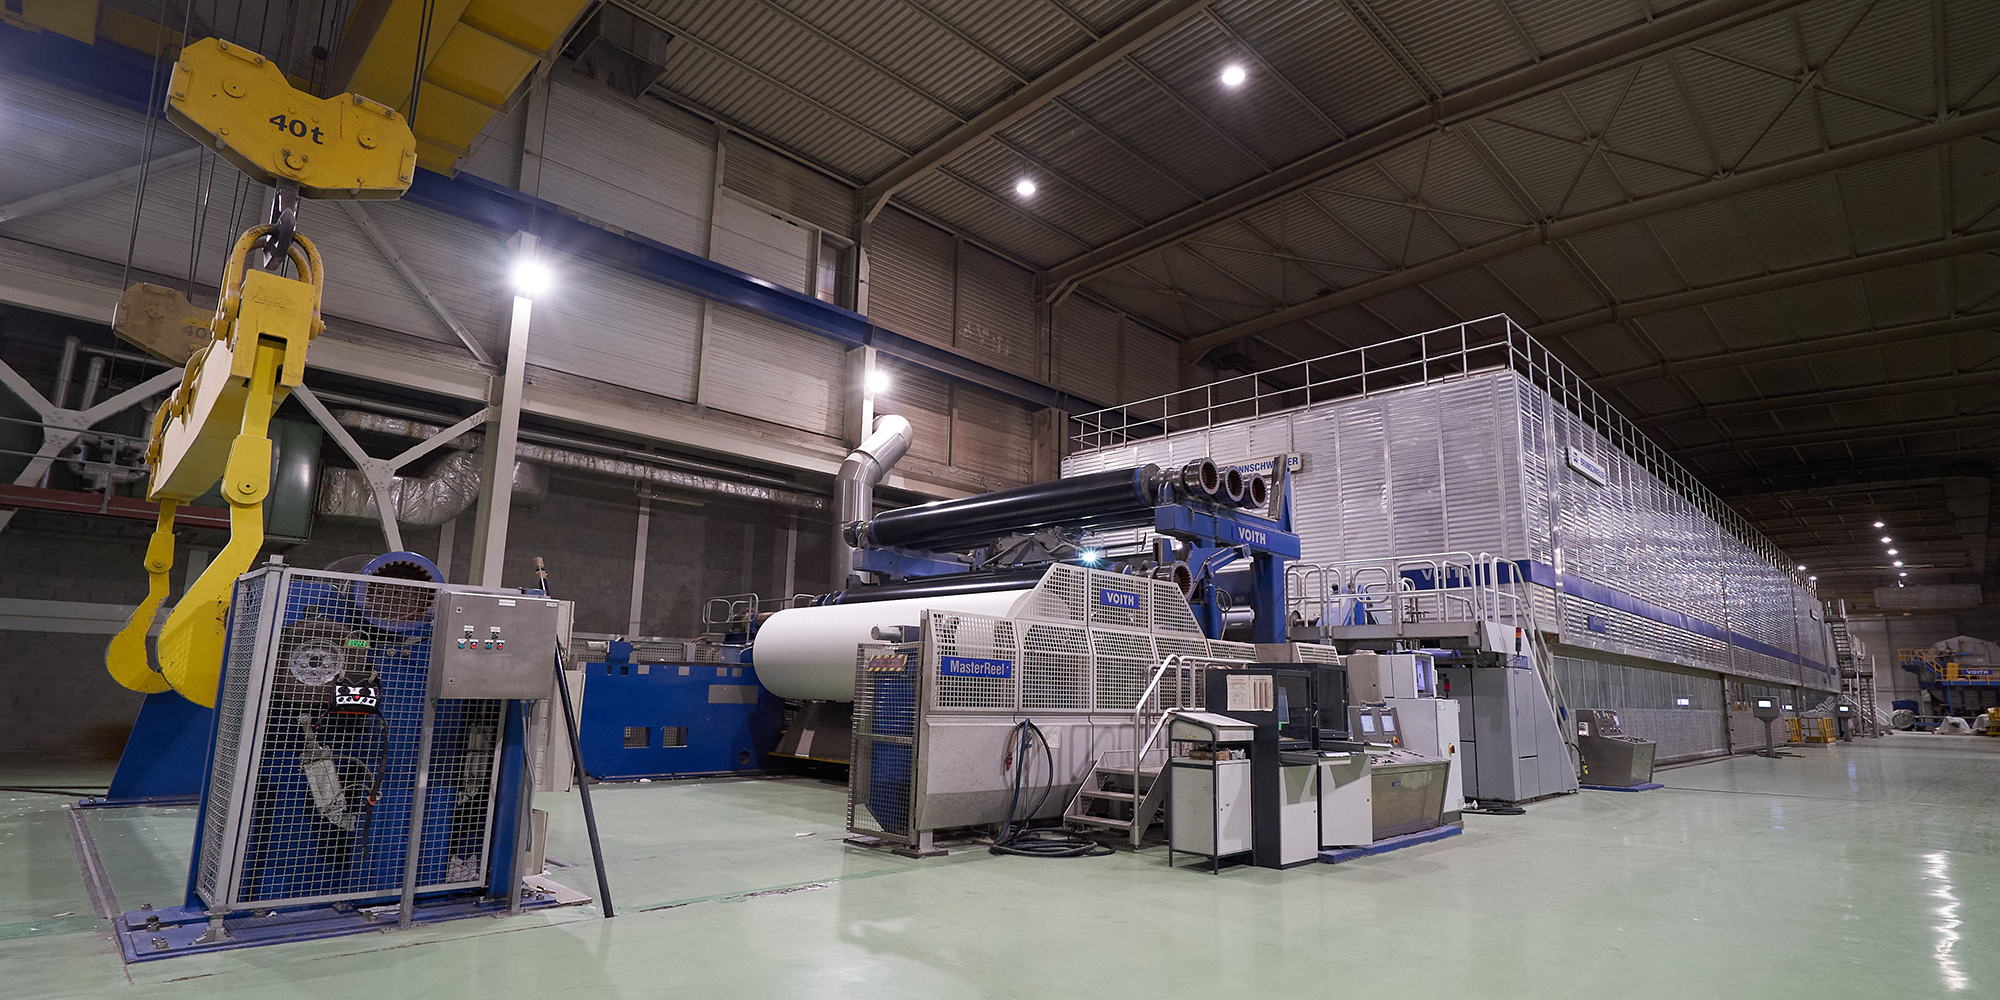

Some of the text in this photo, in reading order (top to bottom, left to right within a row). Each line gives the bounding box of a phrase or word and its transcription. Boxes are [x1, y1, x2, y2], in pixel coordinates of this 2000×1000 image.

[1238, 526, 1266, 545] VOITH
[1106, 592, 1134, 606] VOITH
[950, 660, 1005, 675] MasterReel
